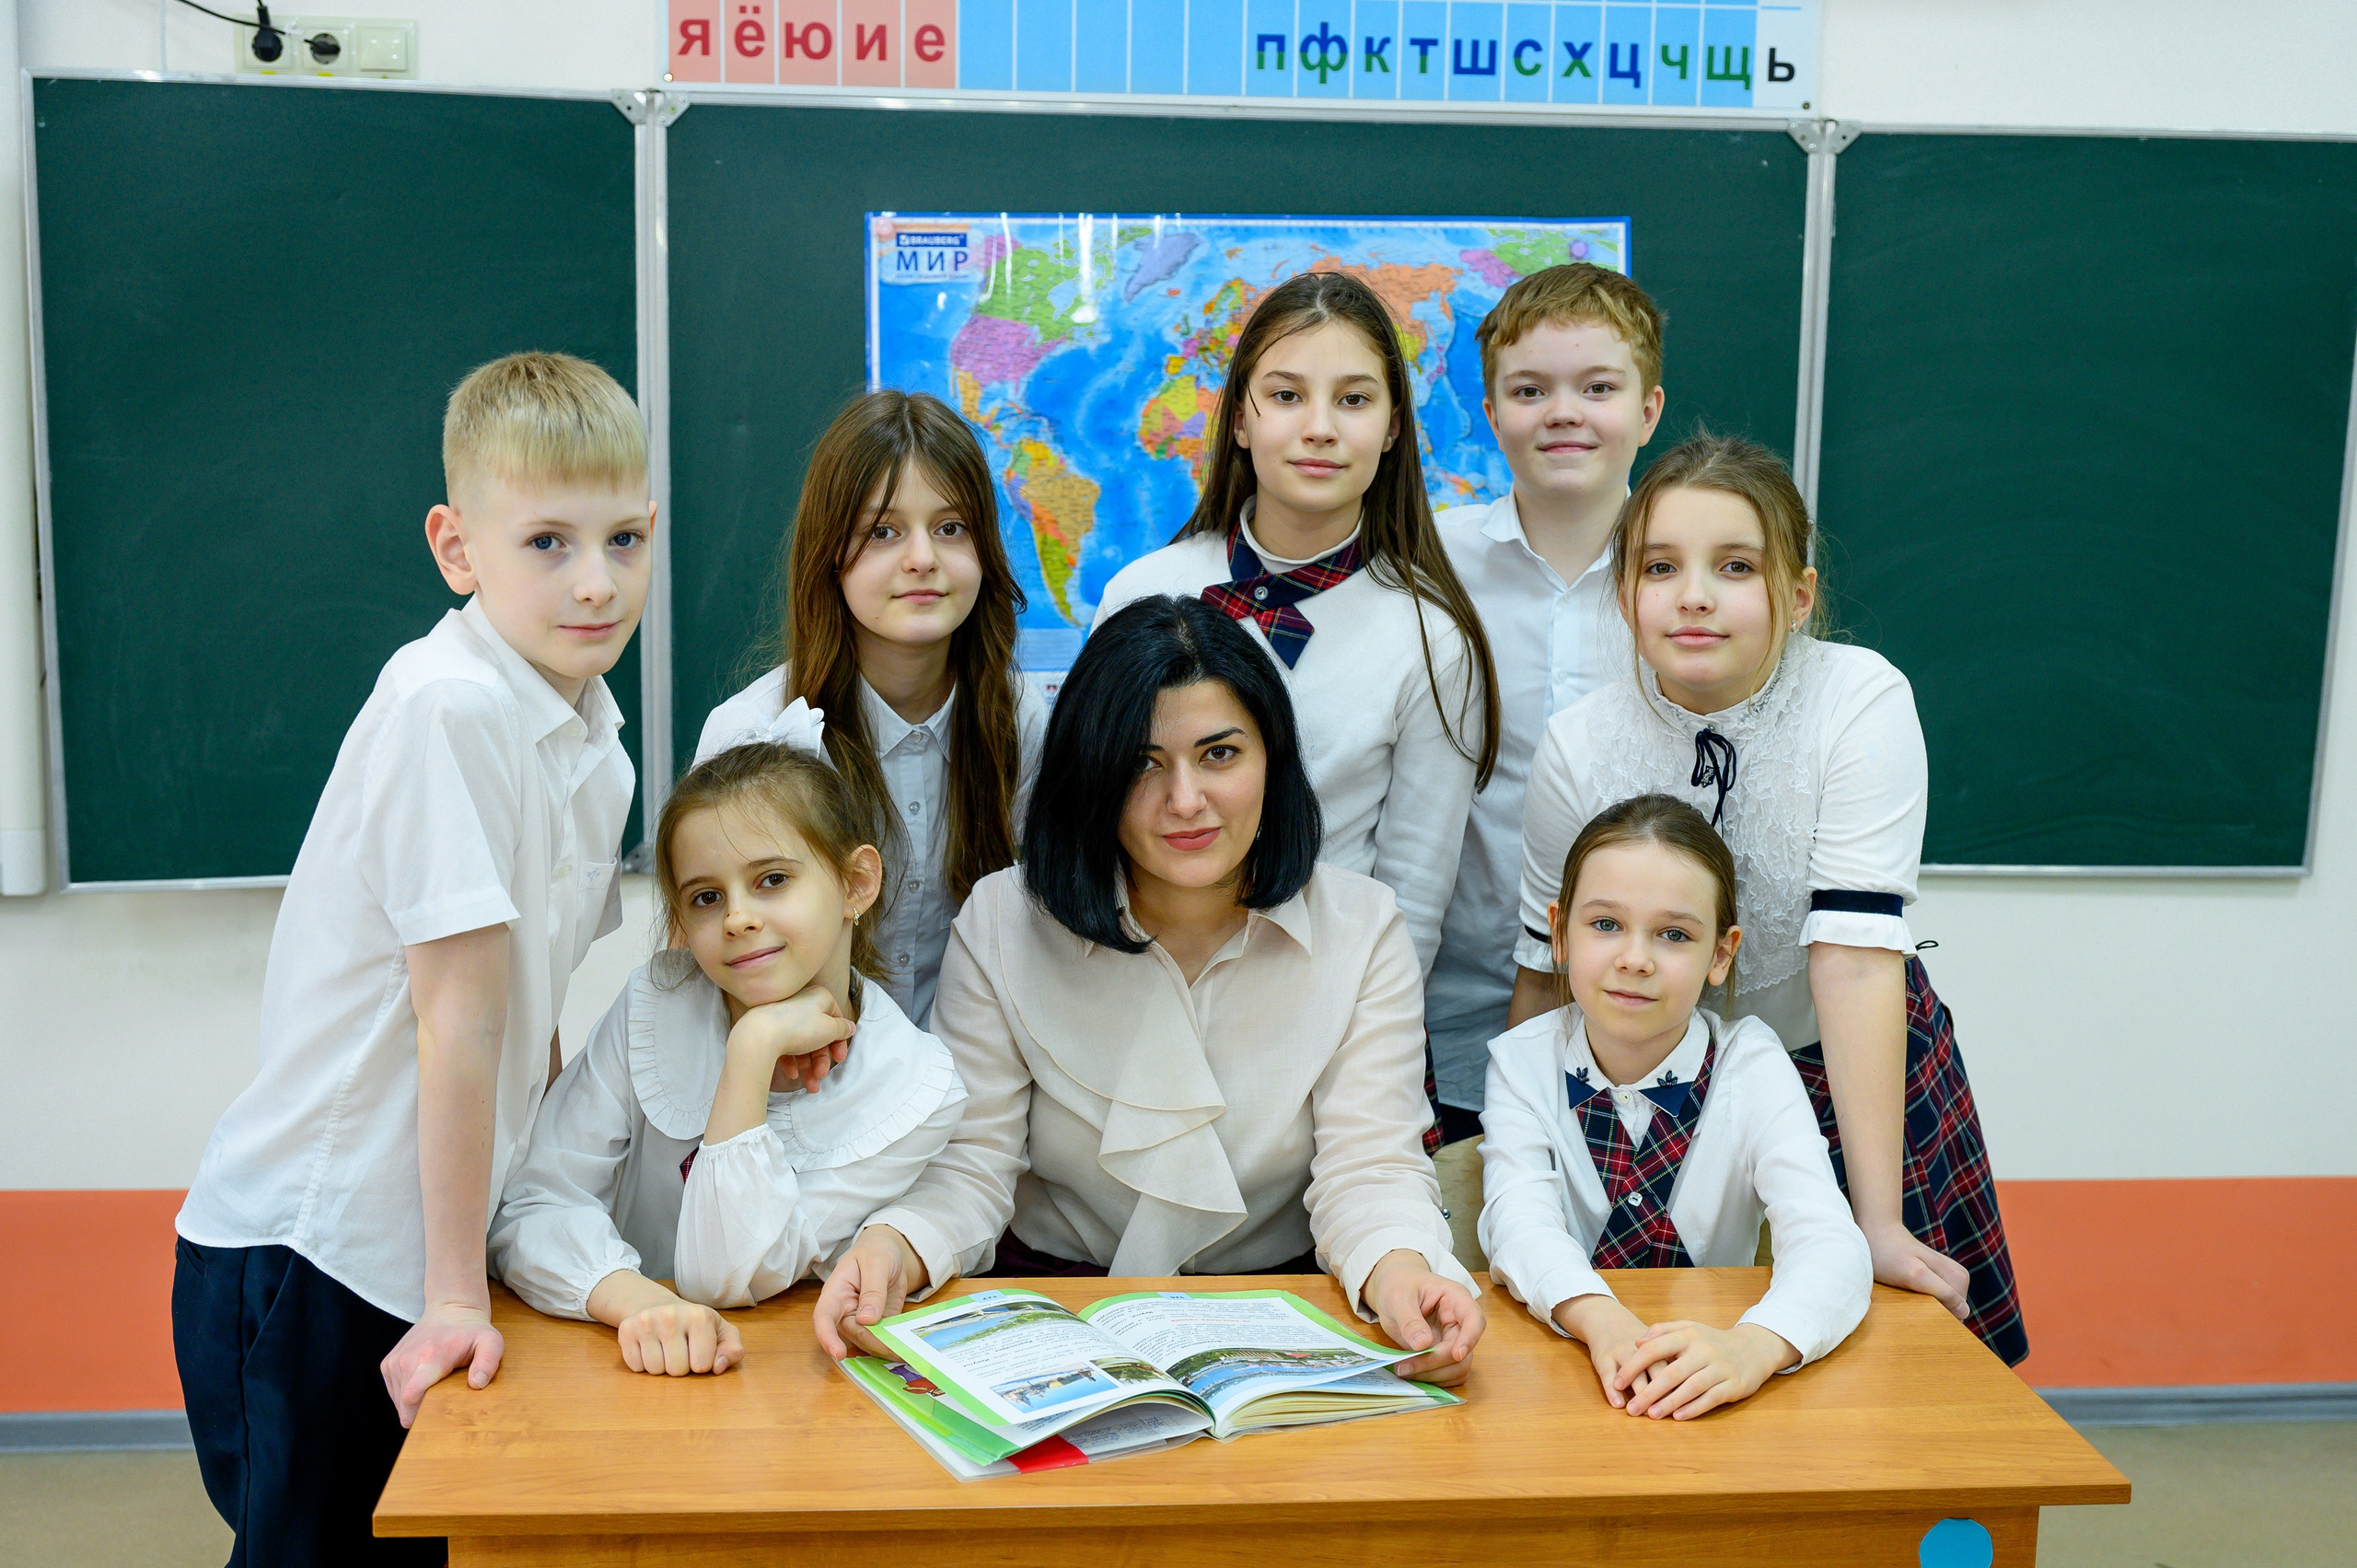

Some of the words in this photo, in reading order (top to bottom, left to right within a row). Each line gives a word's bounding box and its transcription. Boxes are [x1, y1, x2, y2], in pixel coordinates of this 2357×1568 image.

[679, 19, 710, 55] я
[735, 6, 764, 57] ё
[785, 22, 831, 60] ю
[856, 24, 886, 61] и
[915, 25, 945, 62] е
[1258, 35, 1284, 69] п
[1301, 23, 1346, 84] ф
[1366, 38, 1389, 72] к
[1411, 39, 1437, 73] т
[1455, 41, 1495, 75] ш
[1515, 41, 1541, 75] с
[1564, 43, 1590, 76] х
[1610, 44, 1640, 87] ц
[1662, 46, 1688, 79] ч
[1707, 47, 1750, 89] щ
[1769, 48, 1794, 82] ь
[911, 236, 960, 246] BRAUBERG
[897, 250, 968, 271] МИР
